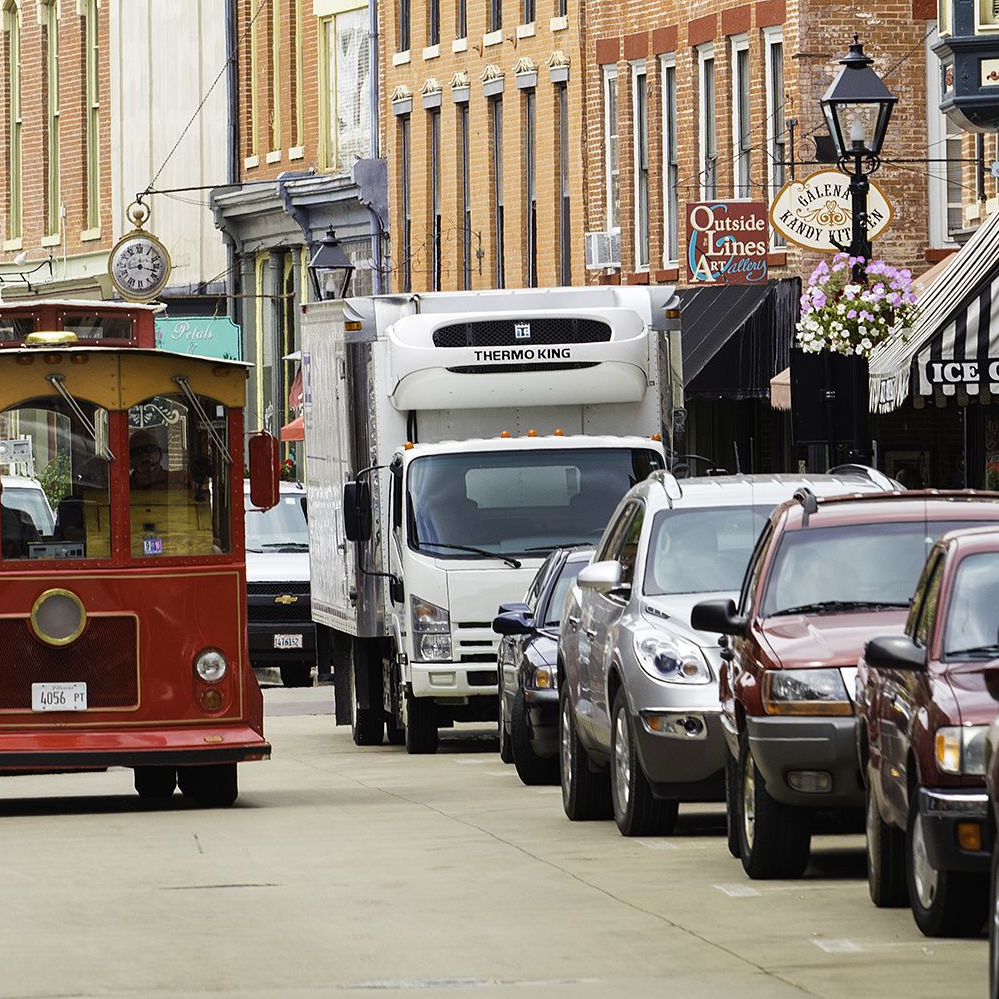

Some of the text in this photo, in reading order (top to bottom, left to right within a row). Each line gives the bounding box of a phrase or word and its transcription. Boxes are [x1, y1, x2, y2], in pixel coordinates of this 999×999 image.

[797, 183, 851, 207] GALENA
[690, 205, 765, 231] Outside
[779, 208, 884, 242] KANDY KITEN
[705, 230, 766, 256] Lines
[171, 321, 213, 340] Petals
[474, 348, 571, 361] THERMO KING
[932, 362, 980, 383] ICE
[41, 691, 85, 704] 4056 PT
